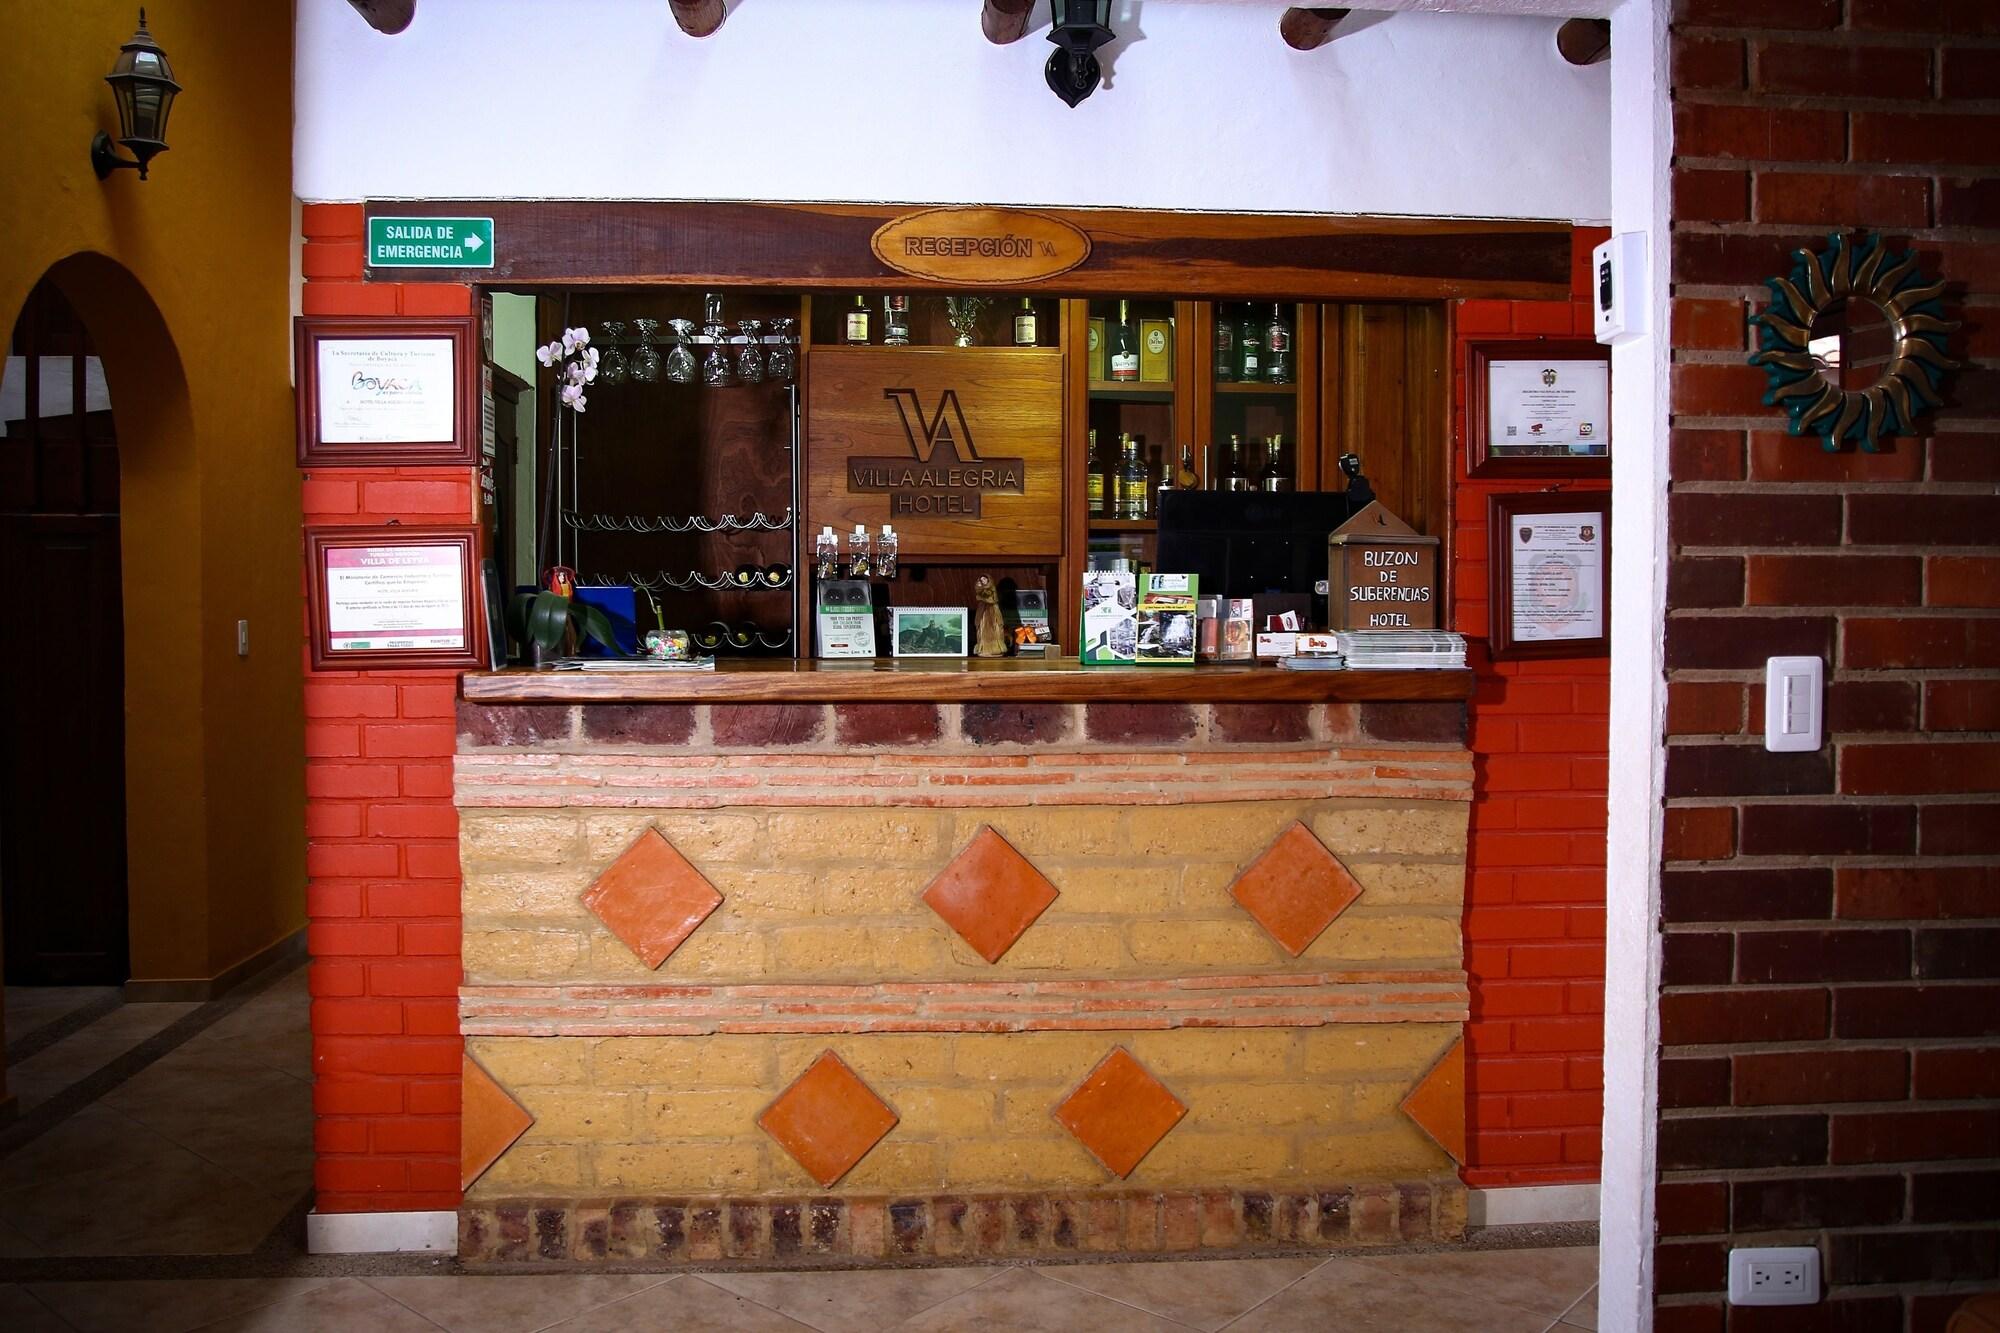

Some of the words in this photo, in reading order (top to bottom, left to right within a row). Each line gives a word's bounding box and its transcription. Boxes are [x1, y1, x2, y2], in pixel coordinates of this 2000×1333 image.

[386, 226, 433, 239] SALIDA
[437, 226, 454, 239] DE
[377, 245, 463, 258] EMERGENCIA
[905, 234, 1032, 257] RECEPCIÓN
[854, 469, 915, 488] VILLA
[919, 469, 1018, 488] ALEGRIA
[899, 495, 974, 513] HOTEL
[1364, 551, 1418, 567] BUZON
[1380, 570, 1397, 583] DE
[1350, 586, 1430, 602] SUGERENCIAS
[1369, 613, 1411, 627] HOTEL
